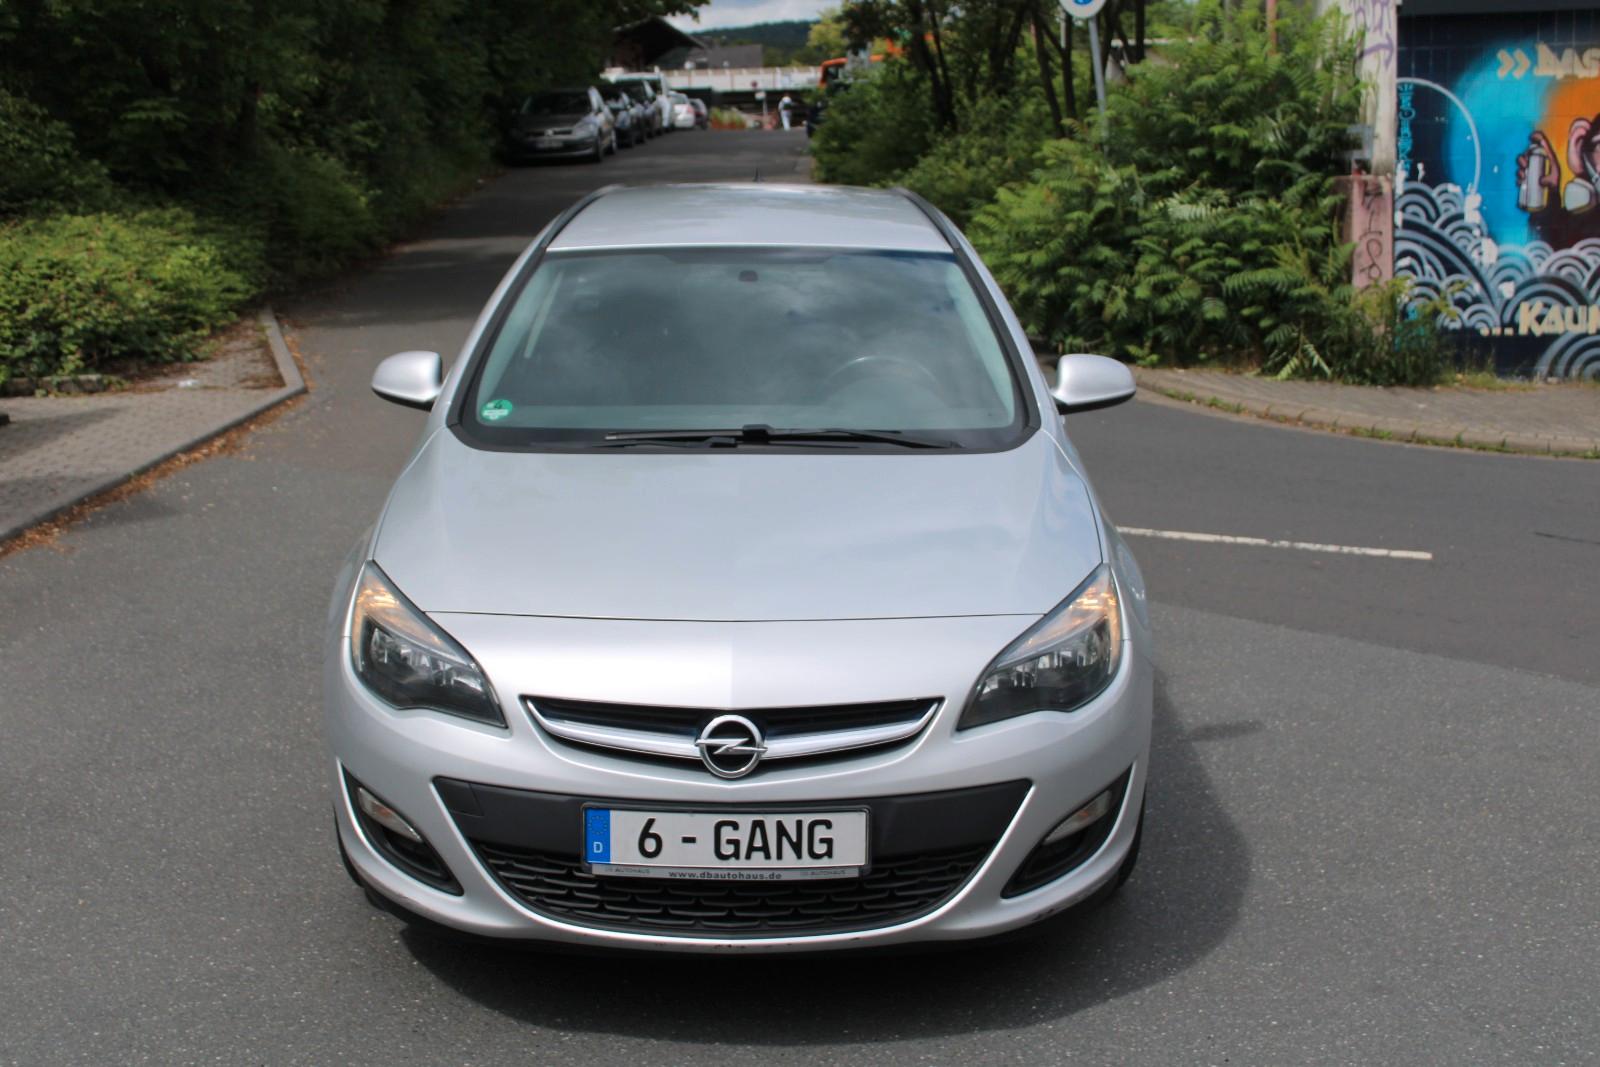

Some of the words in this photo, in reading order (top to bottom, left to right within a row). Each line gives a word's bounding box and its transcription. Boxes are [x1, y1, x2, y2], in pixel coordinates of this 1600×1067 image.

[638, 818, 663, 859] 6
[713, 819, 834, 861] GANG
[593, 841, 603, 853] D
[668, 871, 782, 880] www.dbautohaus.de
